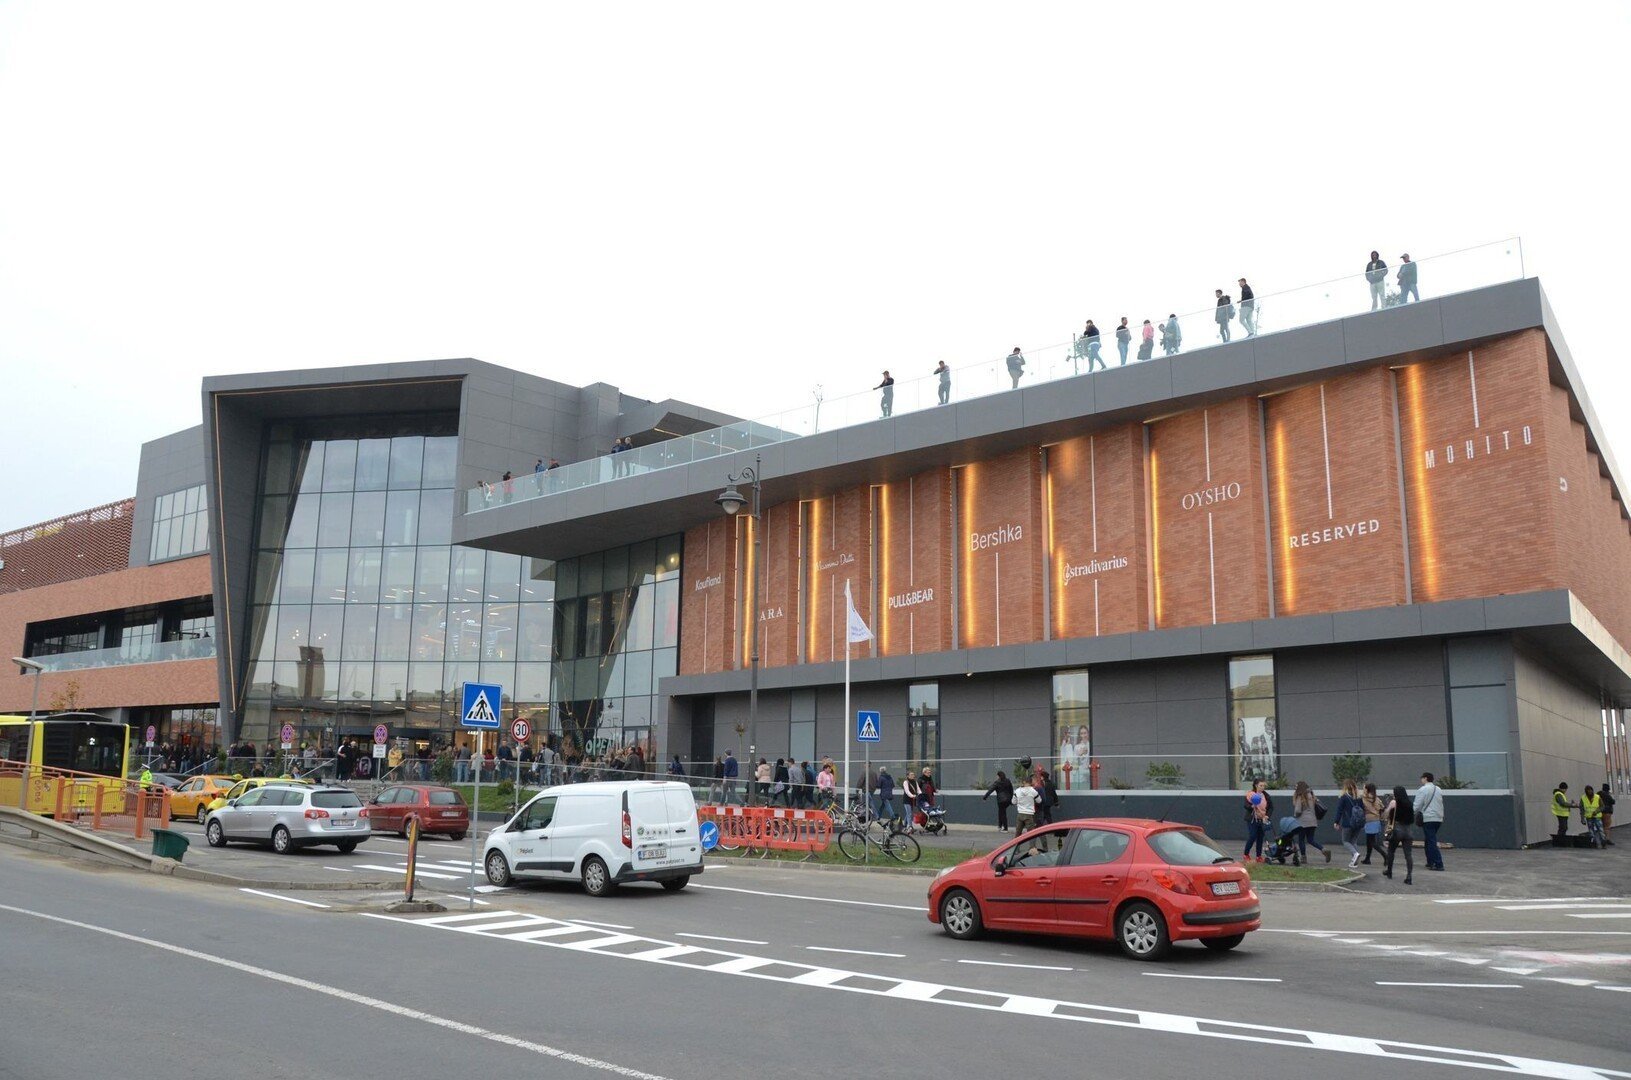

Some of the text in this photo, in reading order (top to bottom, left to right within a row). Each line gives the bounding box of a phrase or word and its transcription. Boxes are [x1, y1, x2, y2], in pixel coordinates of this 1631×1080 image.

[1425, 425, 1532, 470] MOHITO
[1181, 482, 1241, 511] OYSHO
[970, 523, 1023, 552] Bershka
[1289, 519, 1380, 549] RESERVED
[695, 572, 722, 592] Kaufland
[888, 588, 934, 610] PULL&BEAR
[759, 606, 784, 621] ARA
[515, 723, 527, 737] 30
